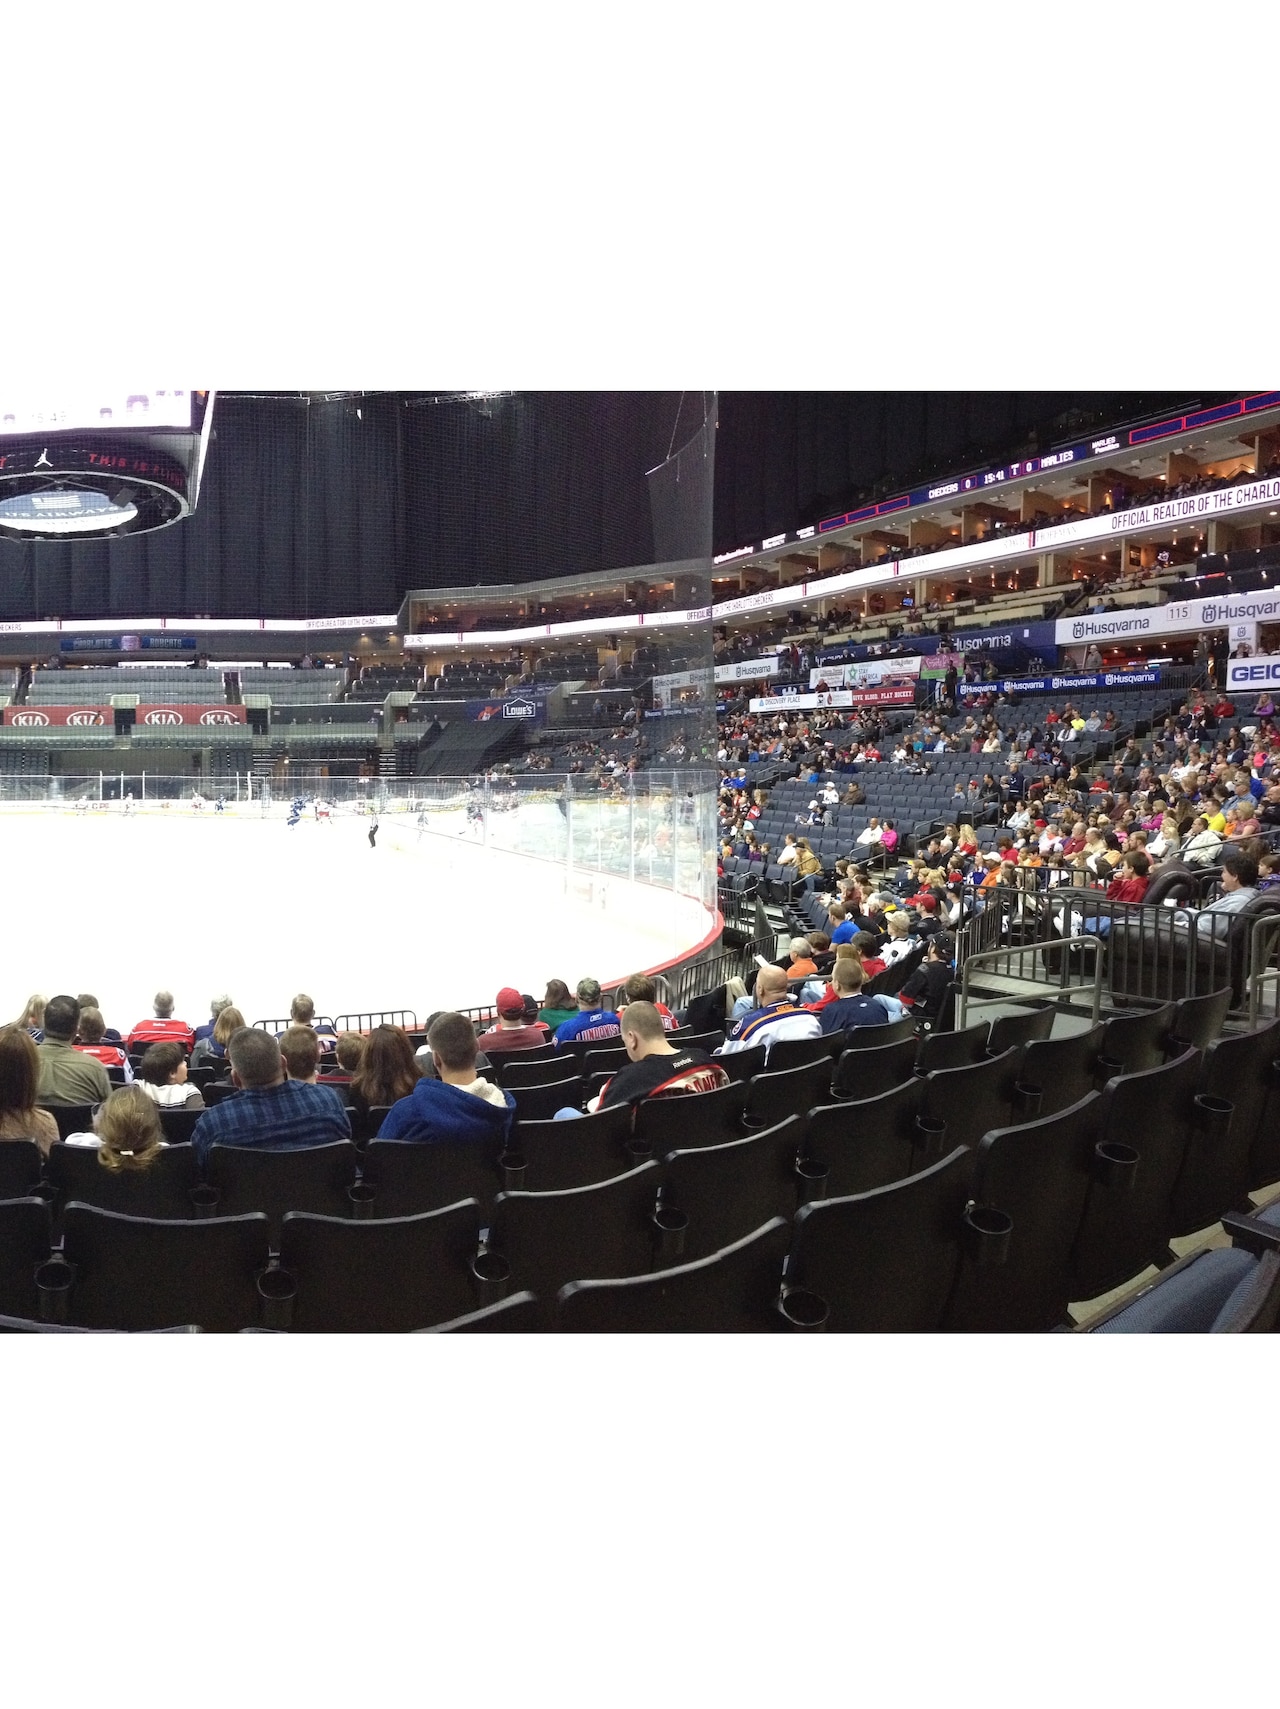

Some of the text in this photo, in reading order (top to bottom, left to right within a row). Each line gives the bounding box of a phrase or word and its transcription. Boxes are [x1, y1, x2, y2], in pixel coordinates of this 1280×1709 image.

[89, 453, 126, 467] THIS
[928, 483, 959, 499] CHECKERS
[984, 470, 1005, 484] 15:41
[1026, 462, 1032, 471] 0
[1040, 451, 1073, 468] MARLIES
[1112, 510, 1150, 530] OFFICIAL
[1154, 499, 1195, 521] REALTOR
[1198, 497, 1210, 512] OF
[1214, 491, 1233, 508] THE
[1169, 607, 1189, 619] 115
[1086, 618, 1150, 636] Husqvarna
[150, 637, 182, 649] BOBCATS
[741, 665, 771, 677] Husqvarna
[1058, 676, 1096, 690] Husqvarna
[1113, 673, 1155, 687] Husqvarna
[967, 682, 997, 694] Husqvarna
[1011, 680, 1045, 693] Husqvarna
[765, 696, 801, 706] DISCOVERY PLACE
[506, 705, 533, 716] LOWE'S
[151, 714, 177, 725] KIA
